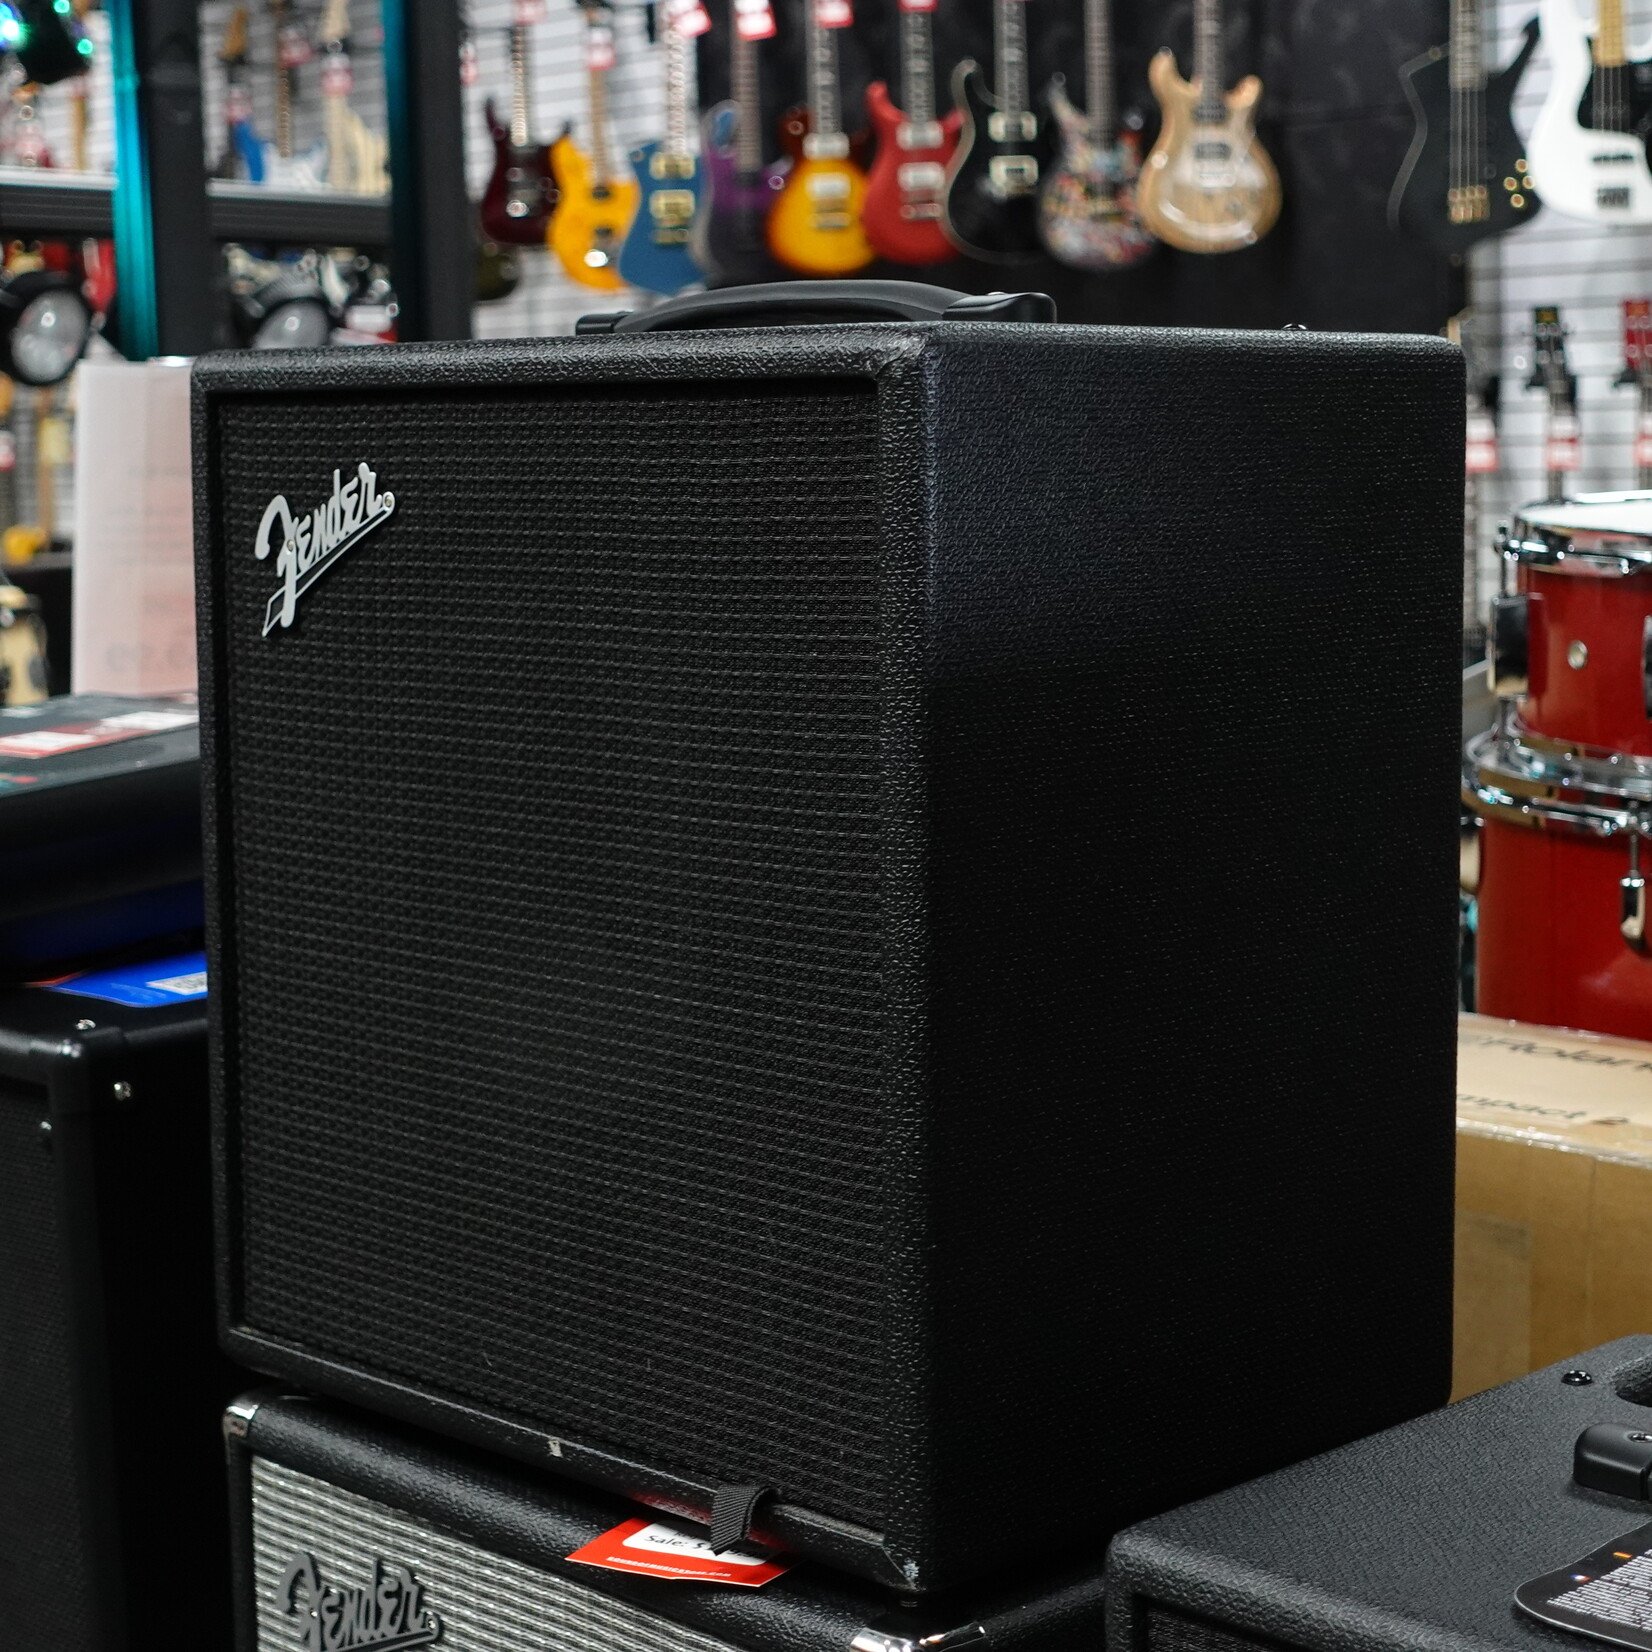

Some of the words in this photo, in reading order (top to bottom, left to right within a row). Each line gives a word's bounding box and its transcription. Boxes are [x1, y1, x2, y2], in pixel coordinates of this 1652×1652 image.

[255, 462, 394, 636] Fender
[645, 1534, 688, 1548] Sale:
[276, 1551, 440, 1652] Fender
